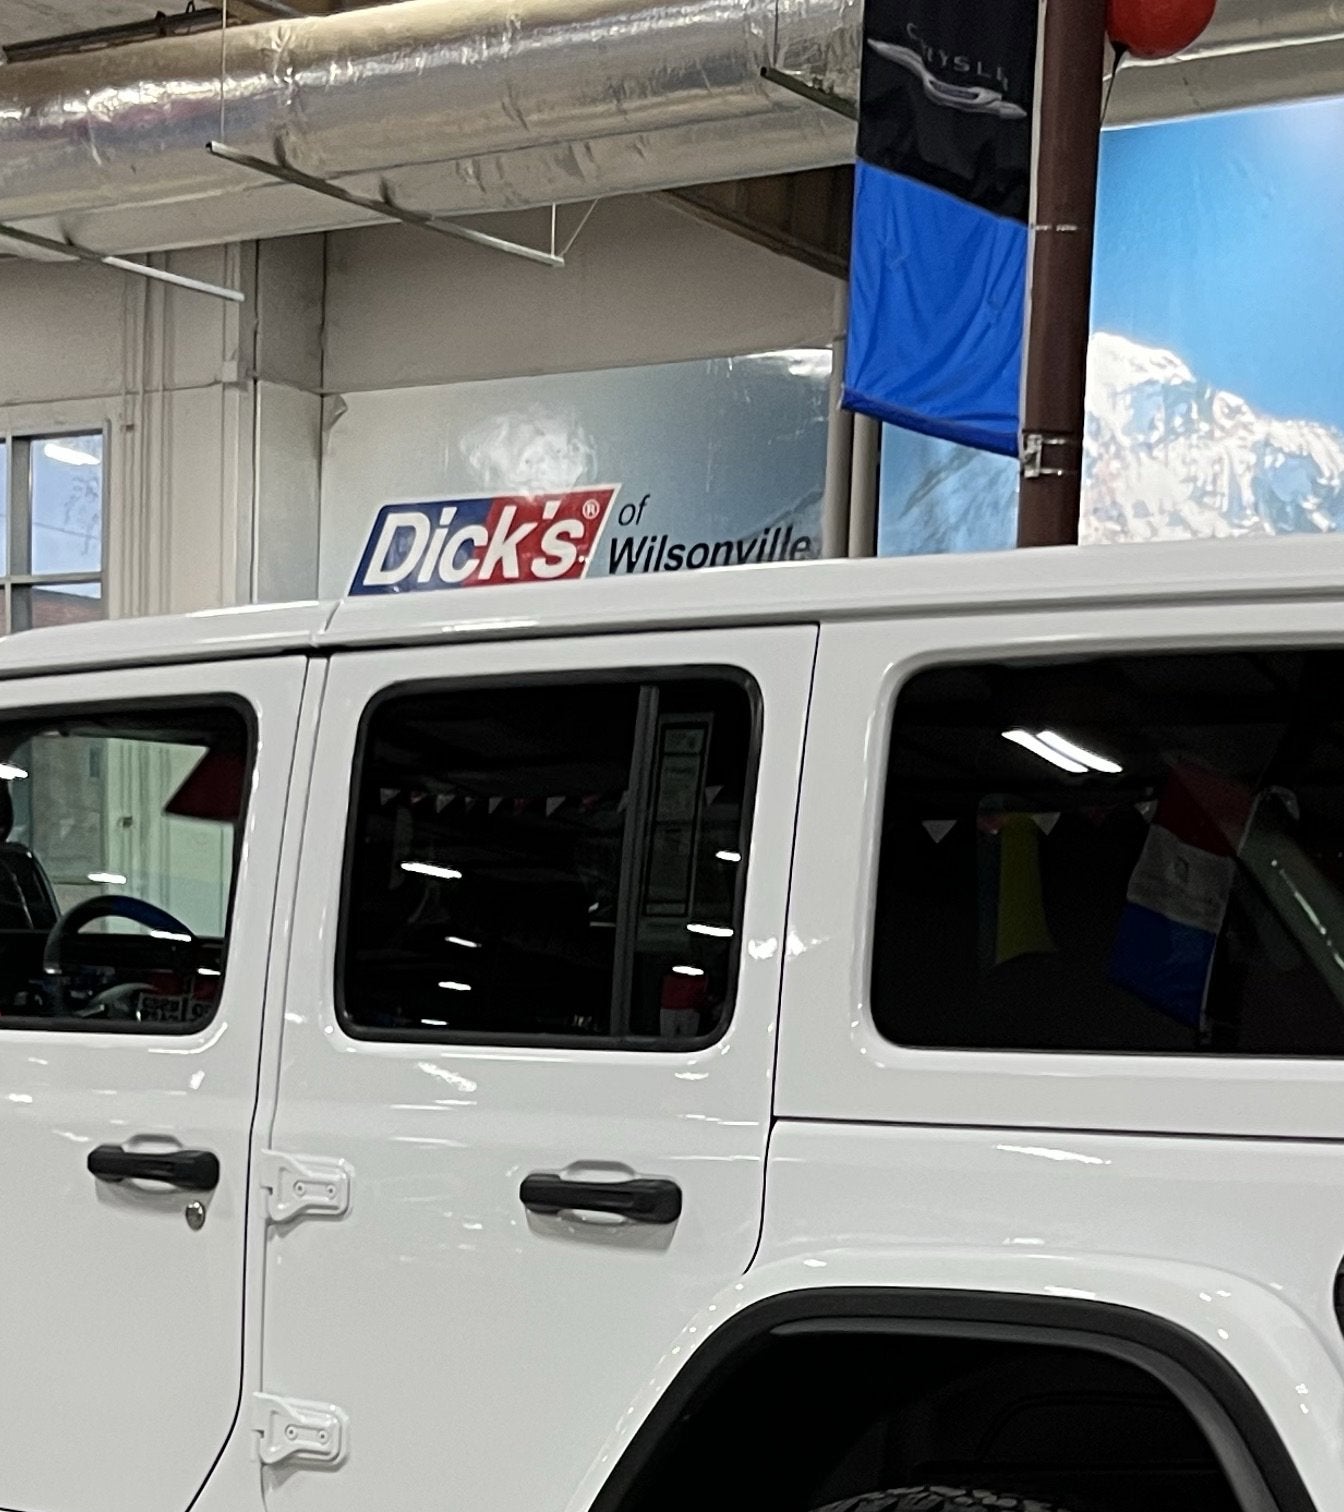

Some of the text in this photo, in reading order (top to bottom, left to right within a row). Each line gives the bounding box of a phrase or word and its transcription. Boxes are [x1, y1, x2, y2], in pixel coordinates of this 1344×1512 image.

[362, 494, 651, 587] Dick's of
[608, 523, 813, 575] Wilsonville
